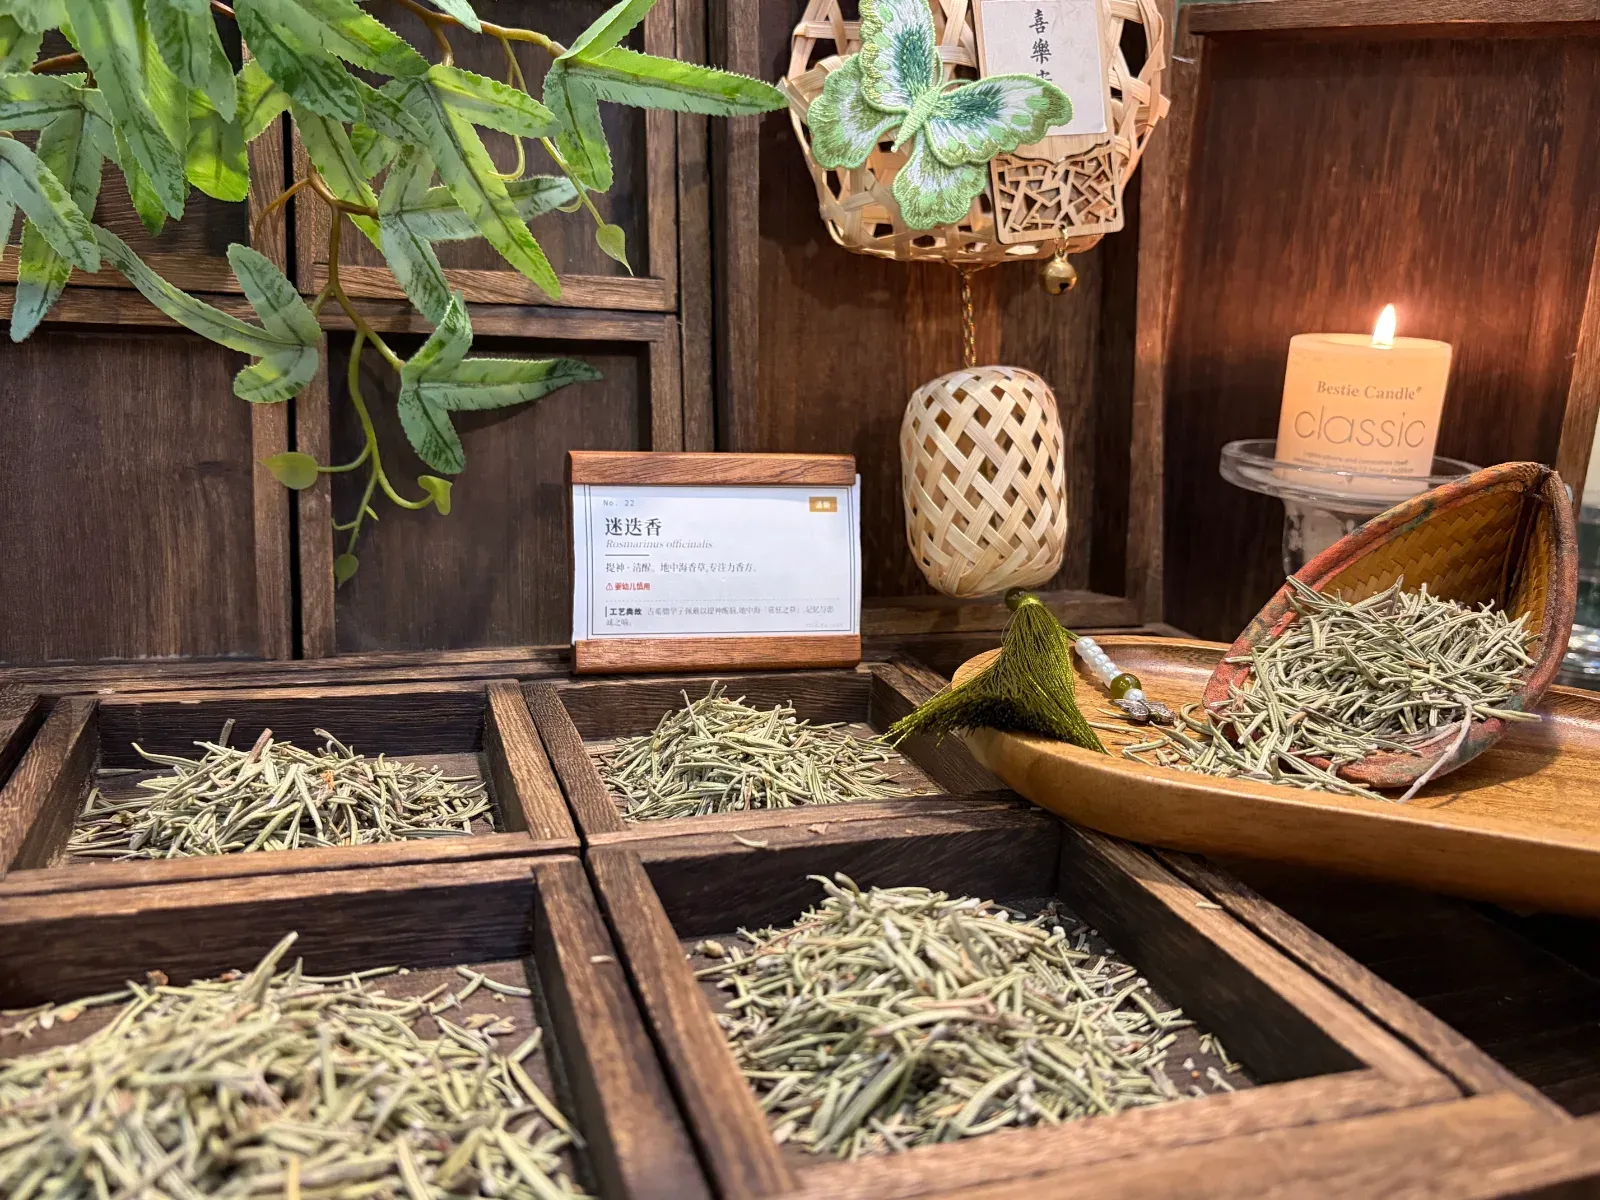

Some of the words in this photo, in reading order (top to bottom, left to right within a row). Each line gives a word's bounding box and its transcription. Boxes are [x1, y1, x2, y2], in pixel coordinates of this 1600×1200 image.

[1316, 380, 1360, 397] Bestie
[1294, 405, 1426, 448] classic
[604, 517, 662, 537] 迷迭香
[605, 539, 664, 549] Rosmarinus
[666, 539, 713, 549] officinalis
[609, 607, 642, 616] 工艺典故
